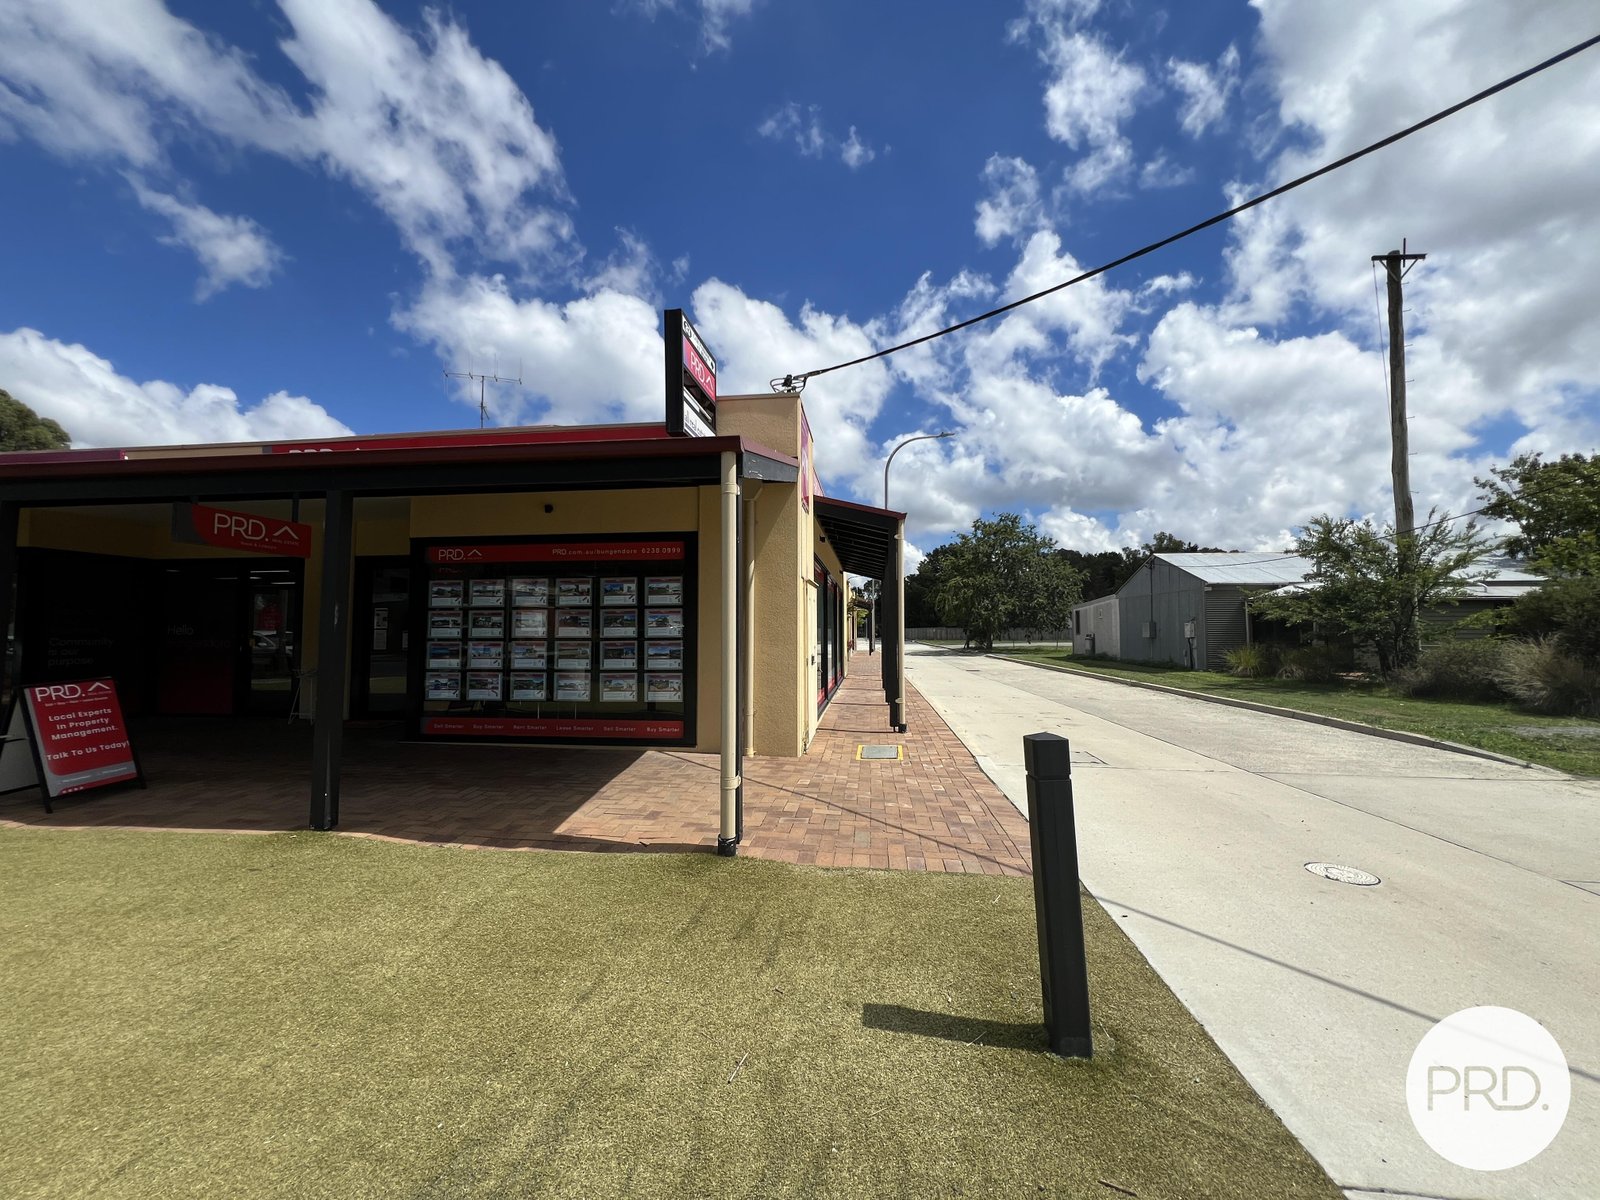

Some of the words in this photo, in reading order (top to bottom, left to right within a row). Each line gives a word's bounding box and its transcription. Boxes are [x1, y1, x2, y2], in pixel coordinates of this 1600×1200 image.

[214, 513, 269, 542] PRD.
[438, 548, 466, 561] PRD.
[35, 684, 86, 702] PRD.
[48, 712, 76, 722] Local
[78, 707, 112, 720] Experts
[69, 717, 110, 729] Property
[51, 724, 118, 741] Management.
[46, 751, 69, 761] Talk
[99, 739, 130, 751] Today!
